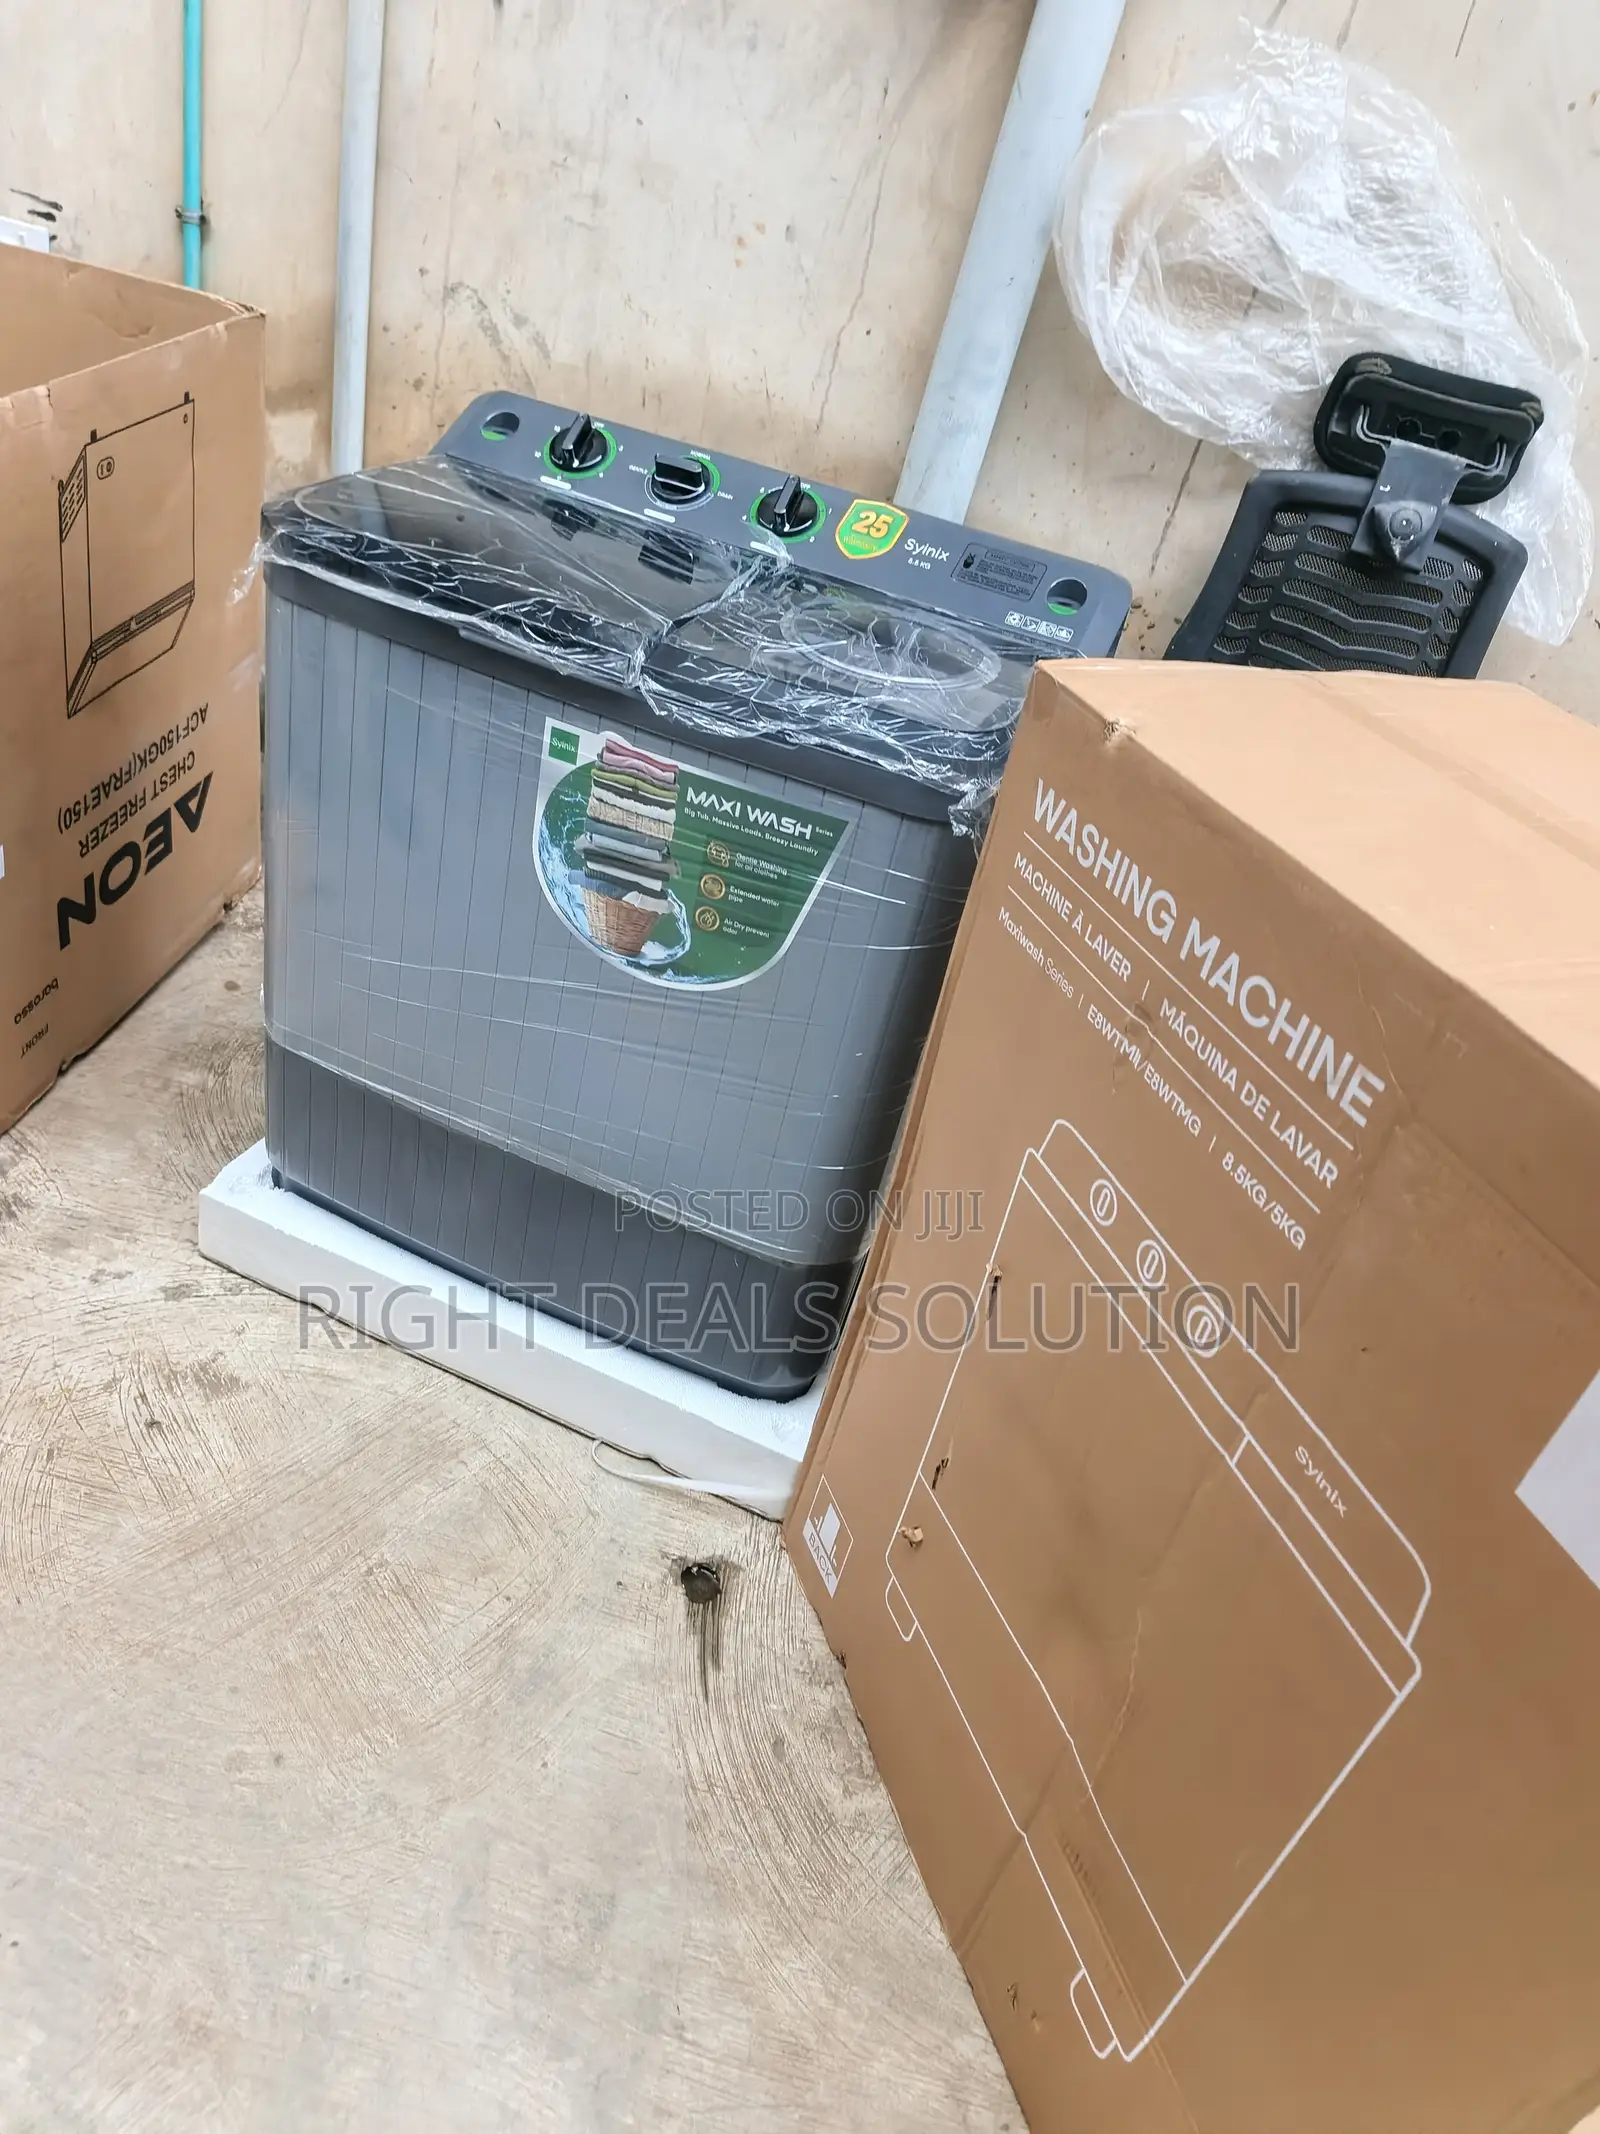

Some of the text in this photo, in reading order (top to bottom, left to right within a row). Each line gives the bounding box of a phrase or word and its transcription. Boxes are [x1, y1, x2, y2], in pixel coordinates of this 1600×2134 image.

[851, 510, 894, 539] 25
[904, 538, 950, 562] Syinix
[57, 701, 209, 835] ACF150GK(FRAE150)
[551, 736, 576, 753] Syinix
[79, 750, 196, 859] CHEST FREEZER
[686, 786, 834, 841] MAXI WASH Series
[684, 807, 696, 818] Big
[711, 815, 740, 831] Massive
[765, 830, 789, 848] Breezy
[789, 836, 819, 857] Laundry
[57, 770, 214, 952] AEON
[736, 852, 788, 876] Gentle Washing
[754, 867, 778, 880] clothes
[728, 894, 744, 904] pipe
[729, 885, 780, 908] Extended water
[724, 917, 771, 939] Air Dry prevent
[1033, 777, 1386, 1129] WASHING MACHINE
[14, 977, 59, 1026] barosso
[1014, 851, 1340, 1190] MACHINE À LAVER MÁQUINA DE LAVAR
[20, 1022, 49, 1060] FRONT
[998, 906, 1045, 967] Maxiwash
[1044, 958, 1075, 998] Series
[1222, 1151, 1307, 1252] 8.5KG/5KG
[1295, 1445, 1347, 1519] Syinix
[808, 1532, 833, 1585] BACK
